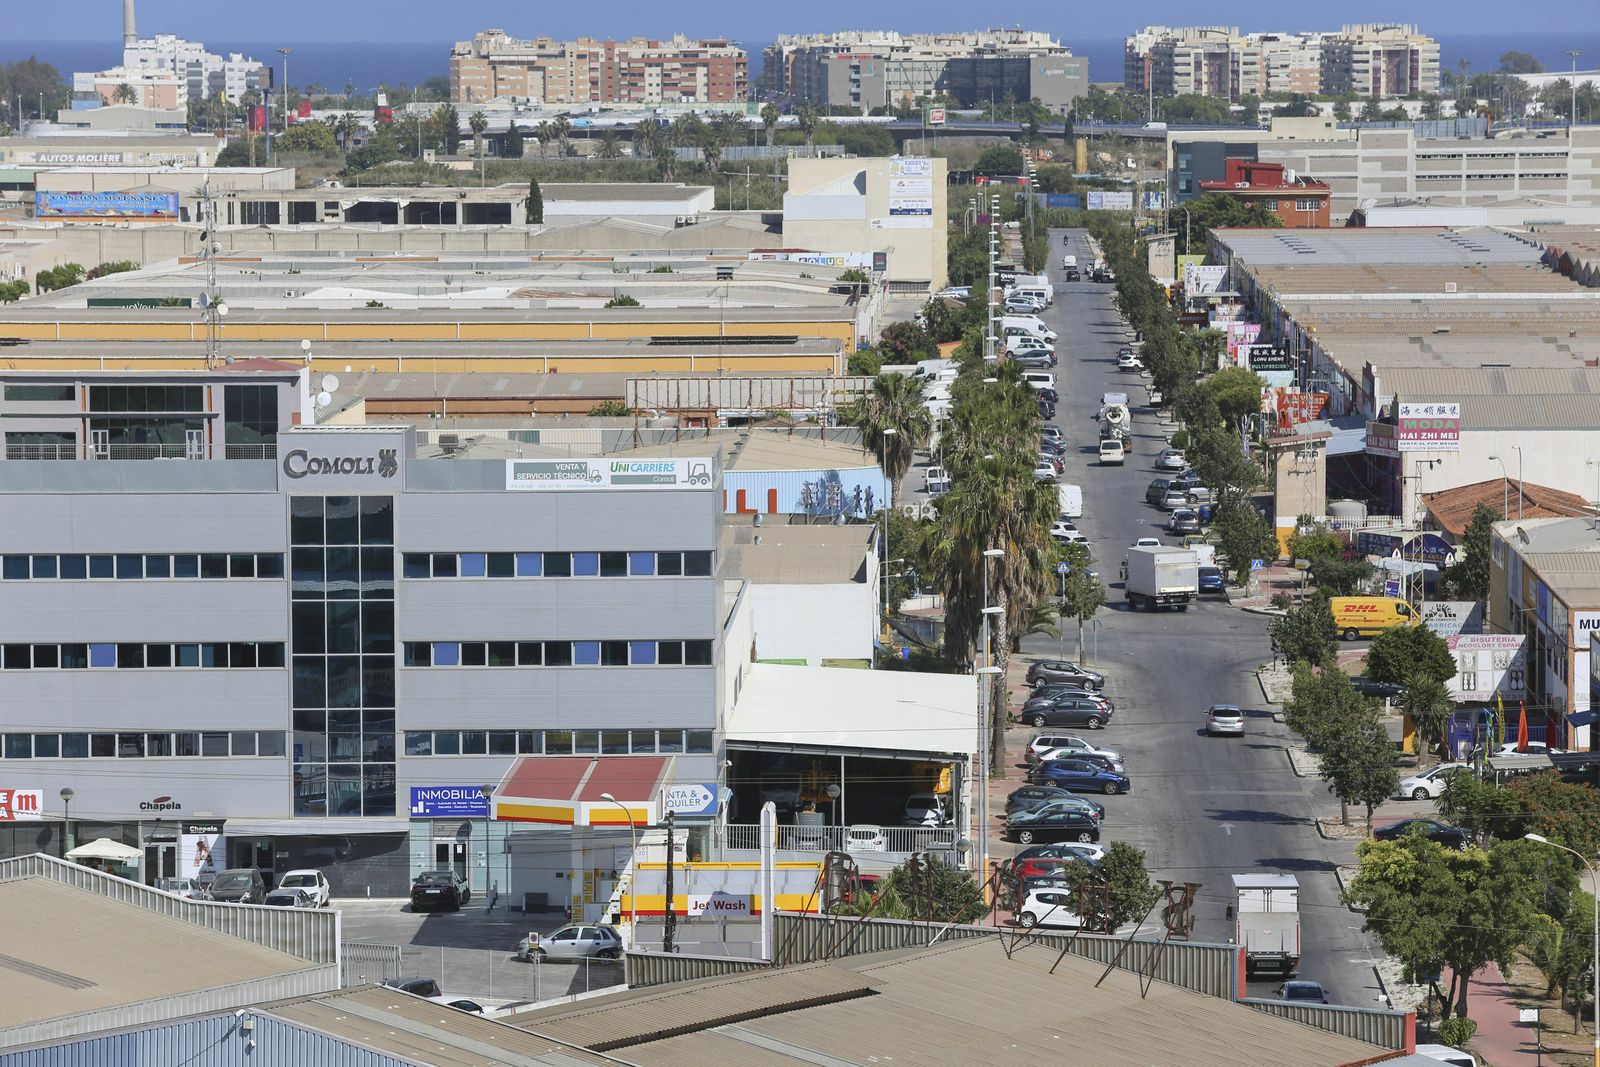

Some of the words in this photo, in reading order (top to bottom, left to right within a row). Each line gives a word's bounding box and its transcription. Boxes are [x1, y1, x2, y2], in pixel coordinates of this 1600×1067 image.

[39, 153, 74, 162] AUTOS
[76, 152, 120, 162] MOLIÈRE
[1403, 419, 1456, 429] MODA
[283, 449, 374, 479] COMOLI
[555, 463, 579, 471] VENTA
[579, 463, 586, 471] Y
[516, 472, 552, 480] SERVICIO
[553, 471, 587, 480] TÉCNICO
[1344, 604, 1378, 613] DHL
[417, 789, 487, 800] INMOBILIA
[690, 789, 697, 798] &
[139, 802, 181, 811] Chapela
[189, 825, 218, 833] Chapela
[692, 900, 710, 911] Jet
[713, 899, 746, 911] Wash
